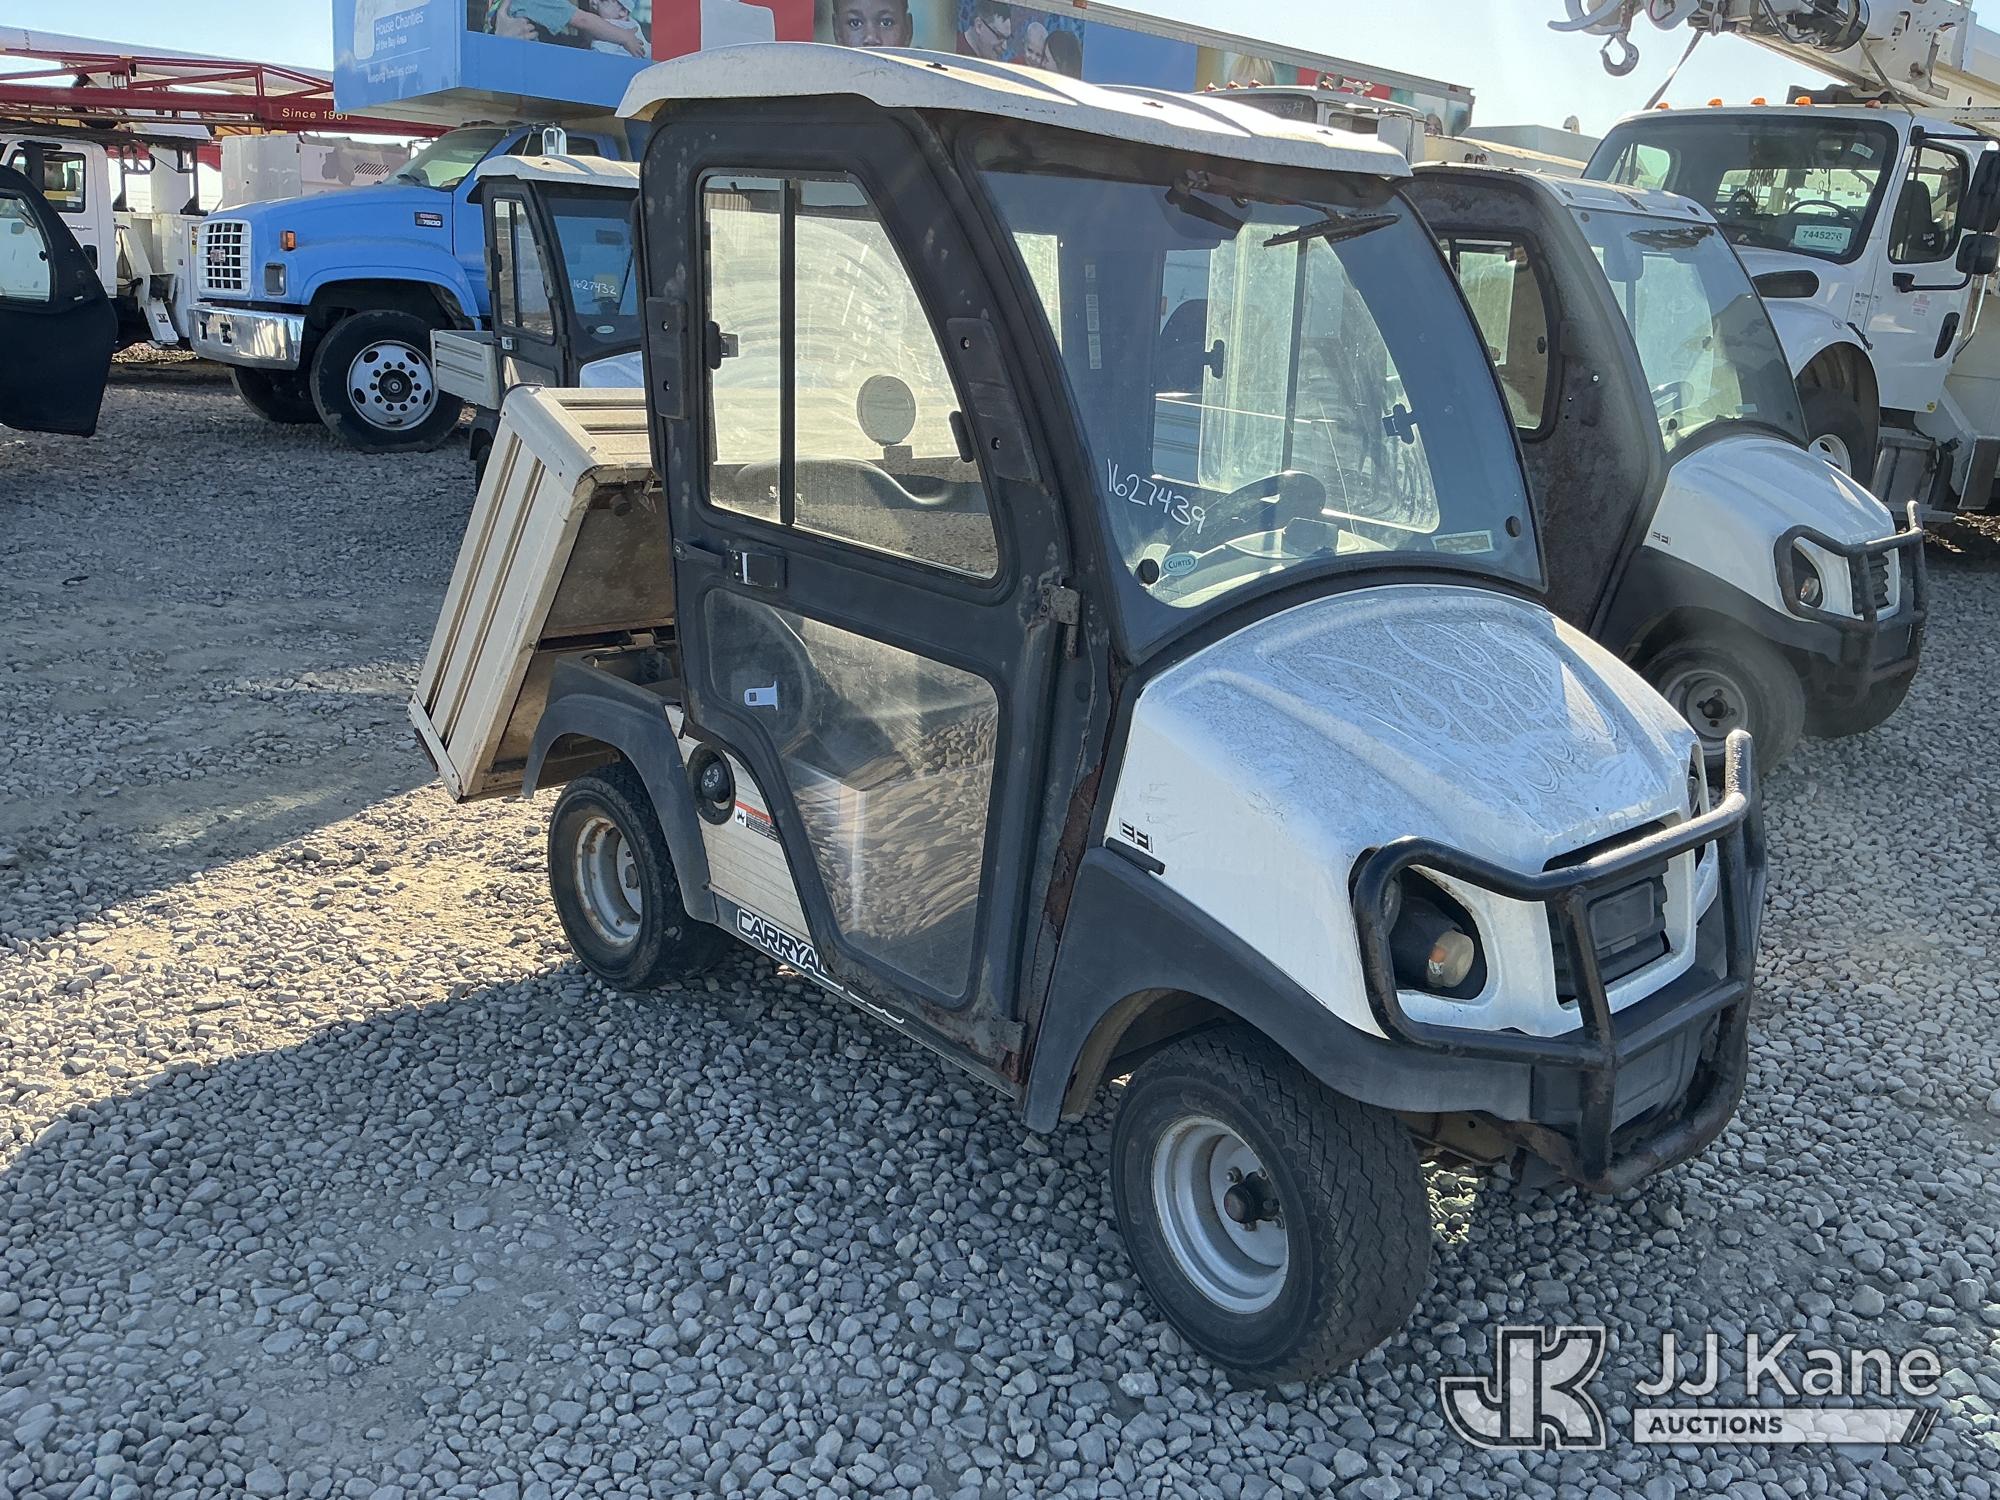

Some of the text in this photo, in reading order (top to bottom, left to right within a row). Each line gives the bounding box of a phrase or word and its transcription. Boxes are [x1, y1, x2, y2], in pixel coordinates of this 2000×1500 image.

[375, 20, 395, 37] House
[282, 107, 317, 119] Since
[573, 279, 617, 295] 1627432
[1107, 457, 1206, 535] 1627439
[736, 907, 844, 991] CARRYA
